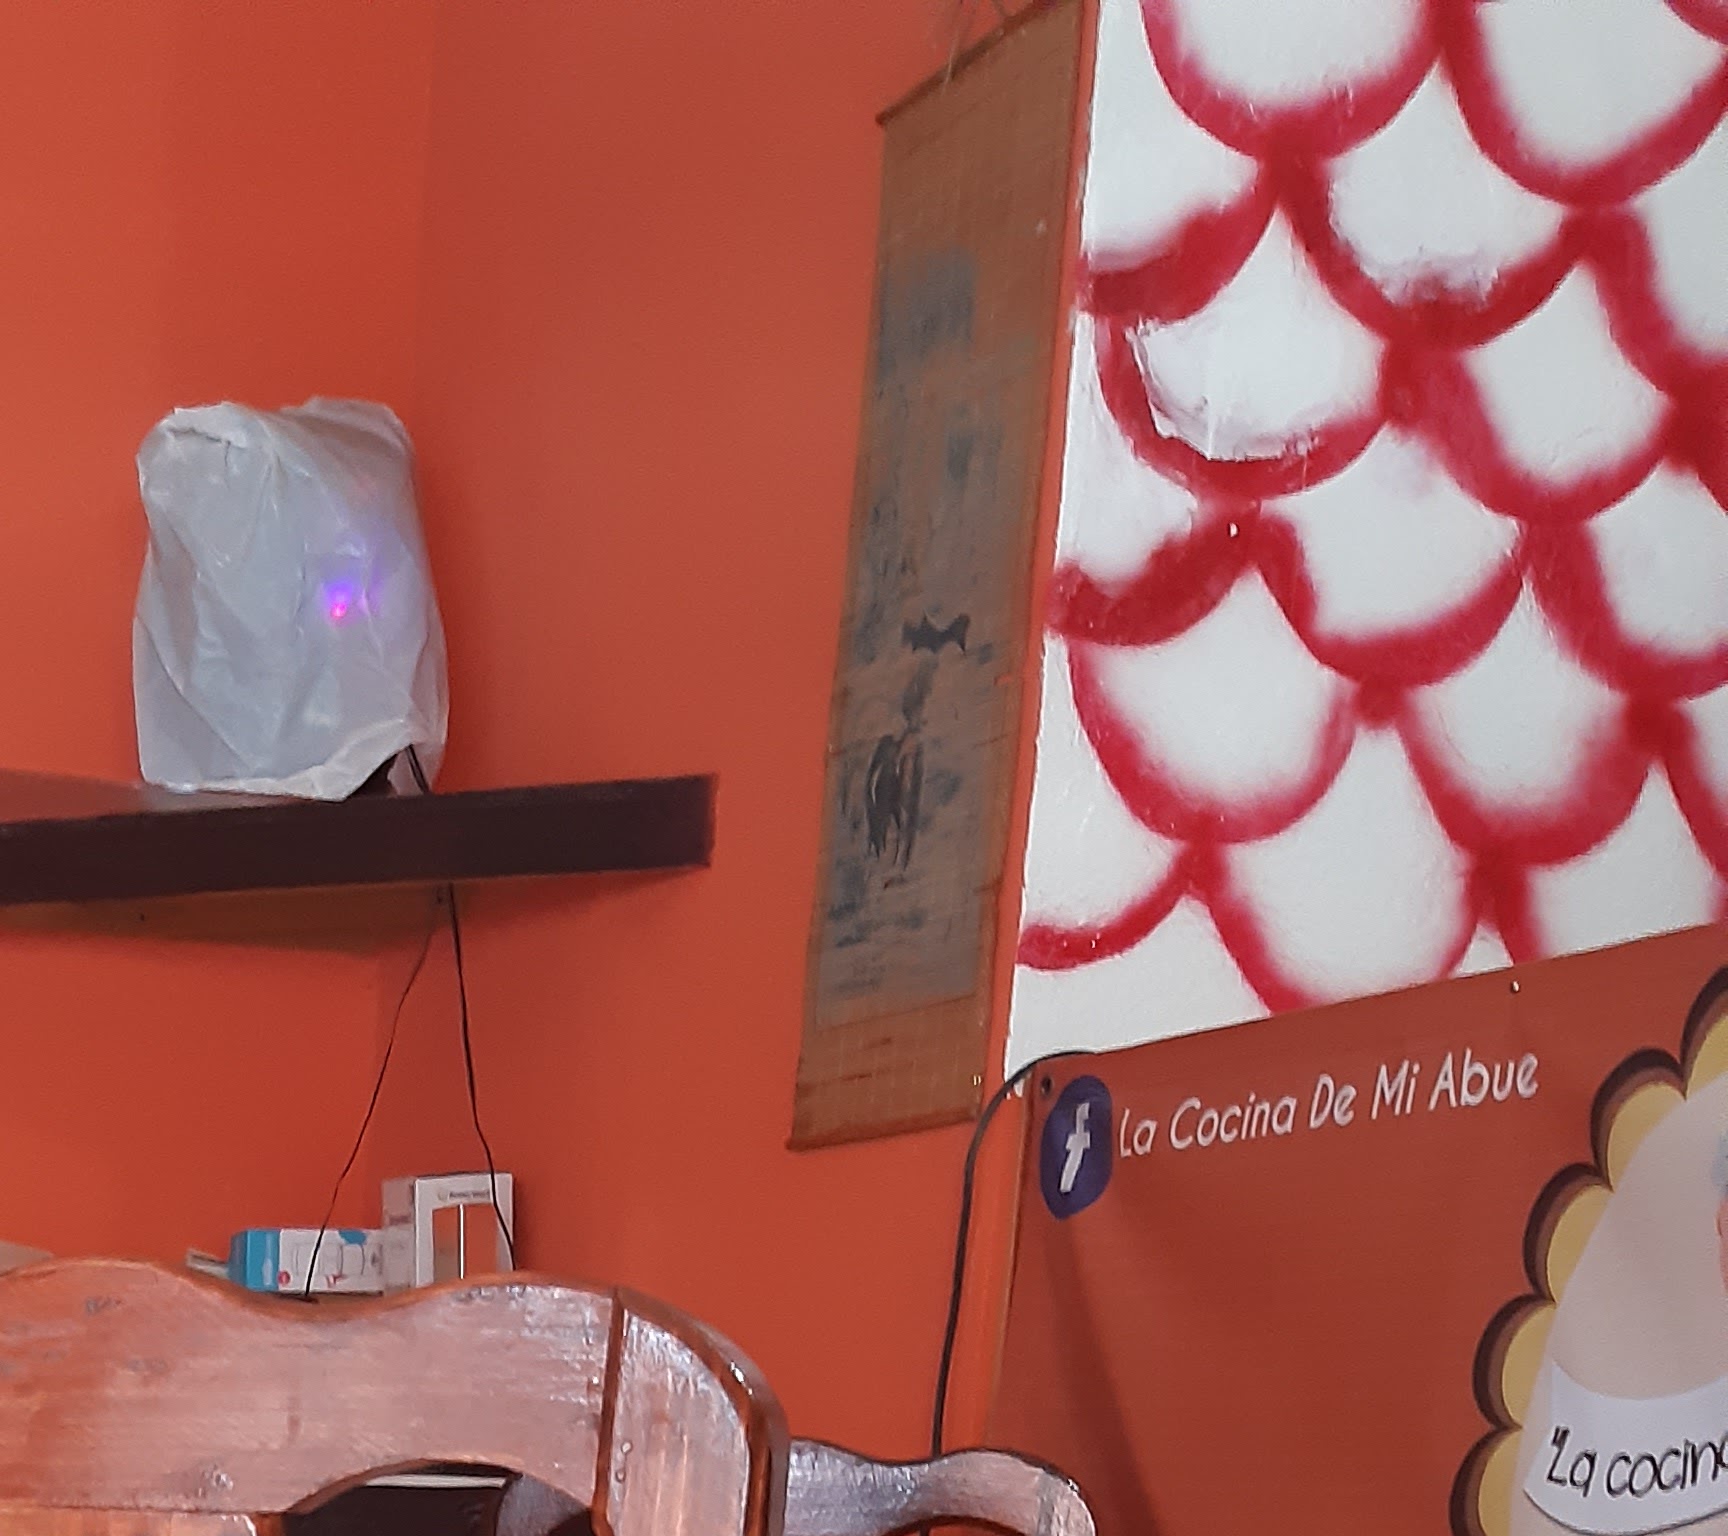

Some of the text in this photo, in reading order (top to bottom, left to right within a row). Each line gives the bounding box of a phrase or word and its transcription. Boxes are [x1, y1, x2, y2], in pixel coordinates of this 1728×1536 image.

[1118, 1048, 1539, 1158] La Cocina De Mi Abue
